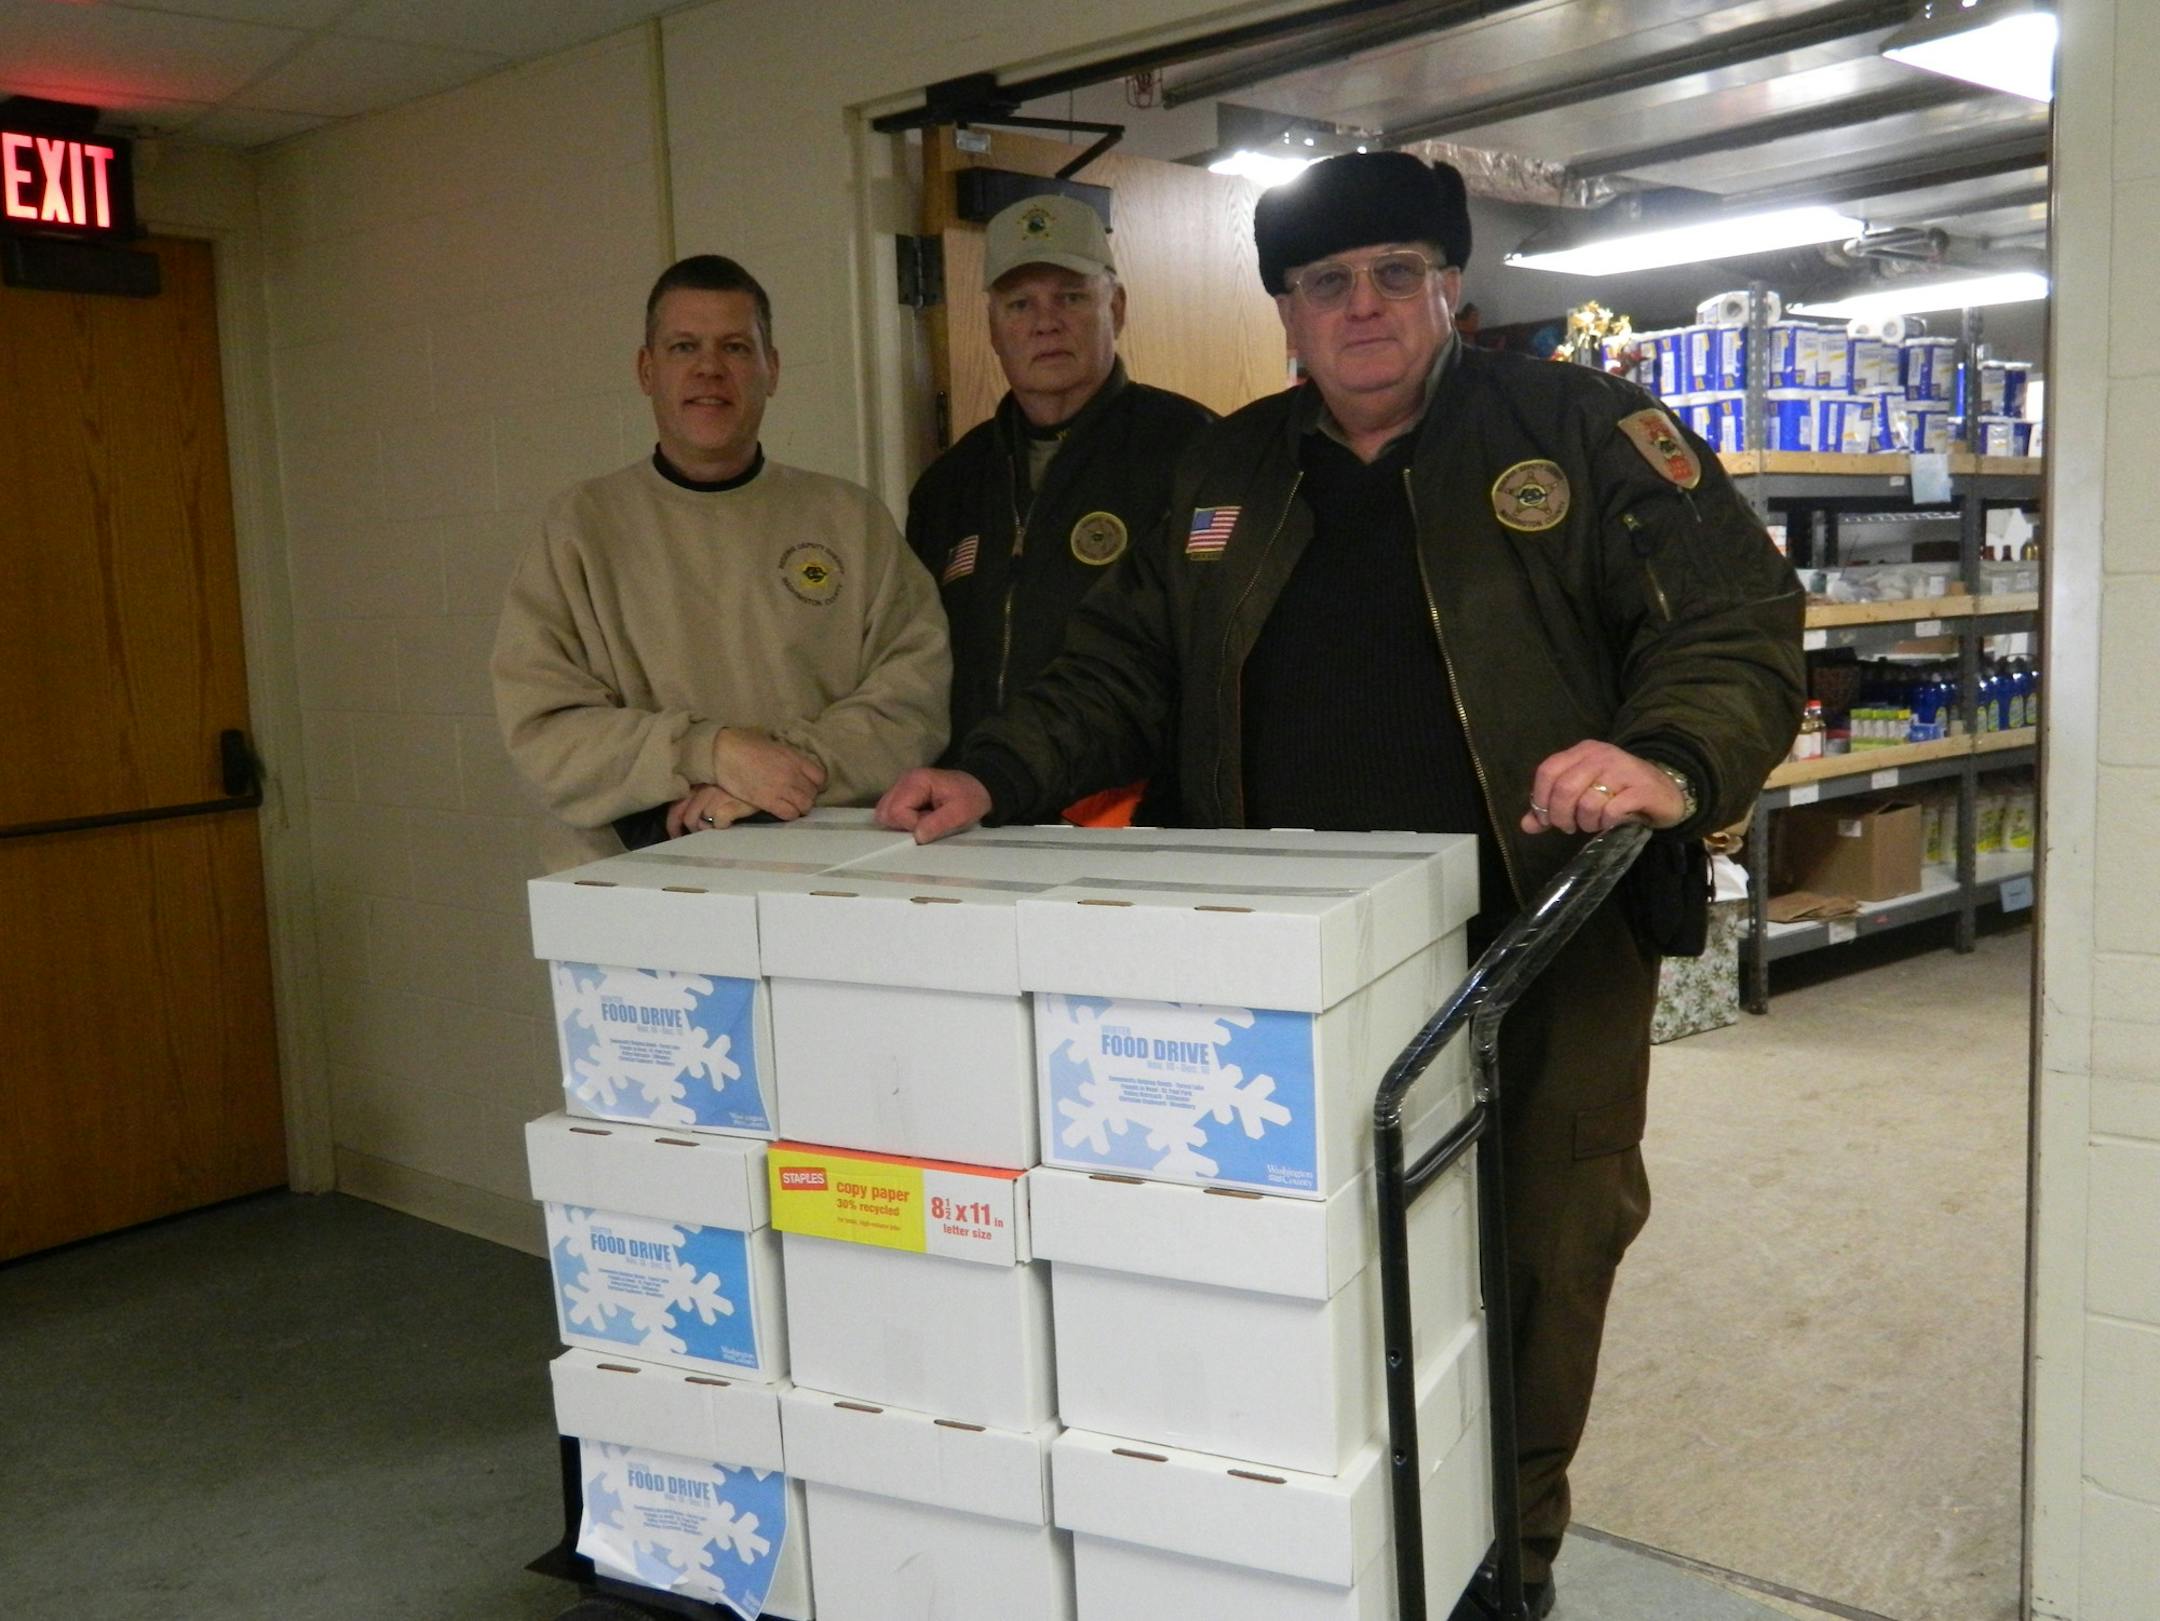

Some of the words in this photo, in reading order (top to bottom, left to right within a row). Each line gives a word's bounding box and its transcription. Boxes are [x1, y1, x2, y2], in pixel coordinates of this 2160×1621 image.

[1, 132, 116, 228] EXIT
[601, 1003, 638, 1023] FOOD
[640, 1006, 683, 1028] DRIVE
[1101, 1034, 1149, 1059] FOOD
[1153, 1039, 1210, 1066] DRIVE
[782, 1172, 826, 1185] STAPLES
[836, 1181, 868, 1198] copy
[872, 1184, 911, 1203] paper
[836, 1198, 858, 1210] 30%
[859, 1202, 901, 1217] recycled
[943, 1223, 969, 1237] letter
[972, 1229, 993, 1241] size
[994, 1217, 1005, 1228] in
[590, 1233, 627, 1256] FOOD
[629, 1239, 672, 1263] DRIVE
[627, 1469, 665, 1493] FOOD
[667, 1476, 711, 1501] DRIVE
